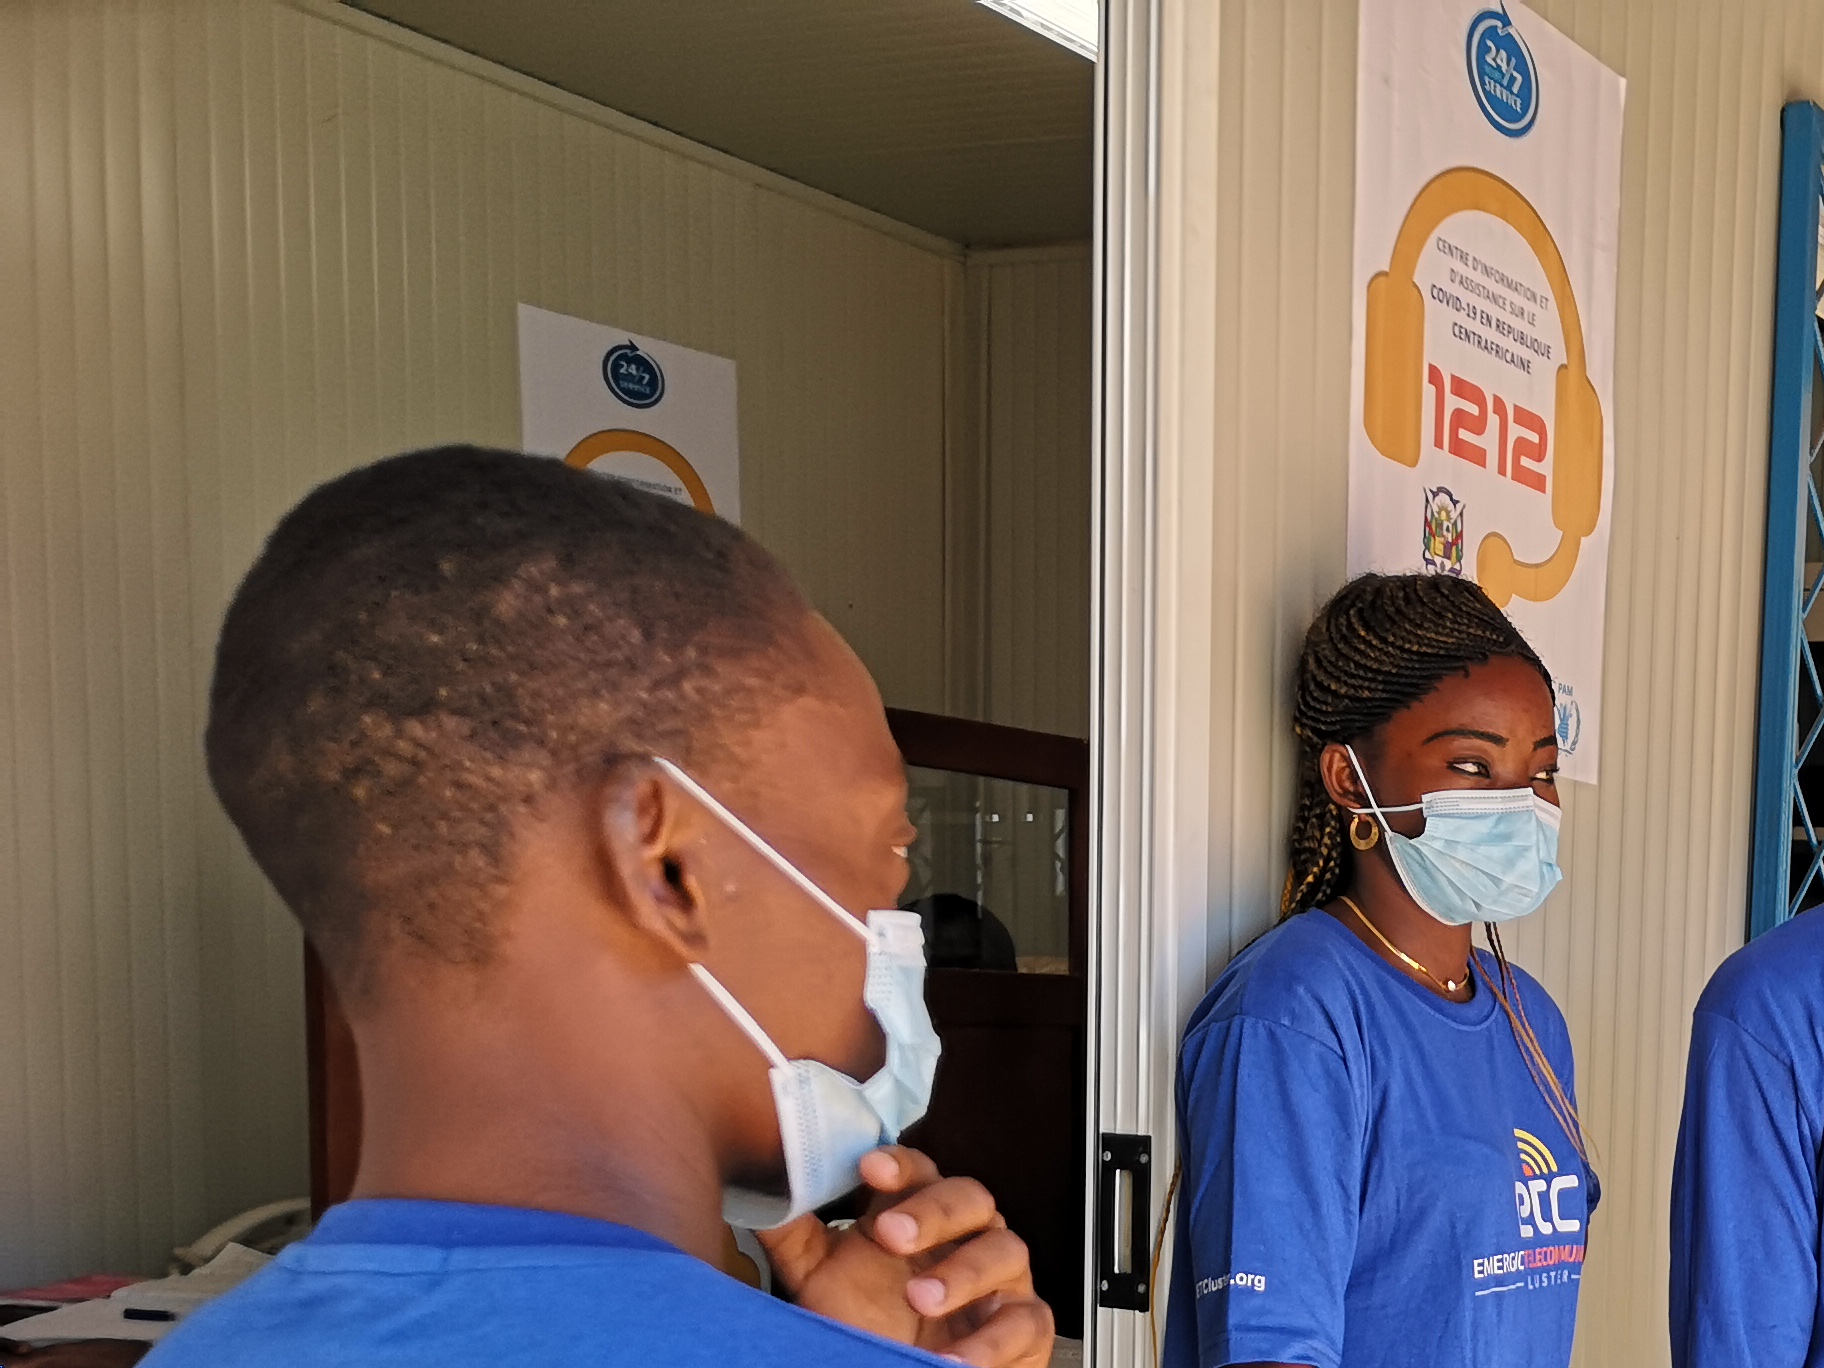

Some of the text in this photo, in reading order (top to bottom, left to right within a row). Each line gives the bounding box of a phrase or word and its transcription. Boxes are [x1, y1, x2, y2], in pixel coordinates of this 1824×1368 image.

[1484, 75, 1522, 114] SERVICE
[1485, 38, 1522, 95] 24/7
[1436, 236, 1549, 311] CENTRE D'INFORMATION ET
[1450, 266, 1537, 327] D'ASSISTANCE SUR LE
[1430, 283, 1552, 360] COVID-19 EN REPUBLIQUE
[1452, 321, 1532, 375] CENTRAFRICAINE
[1428, 362, 1549, 495] 1212
[1557, 682, 1574, 696] PAM
